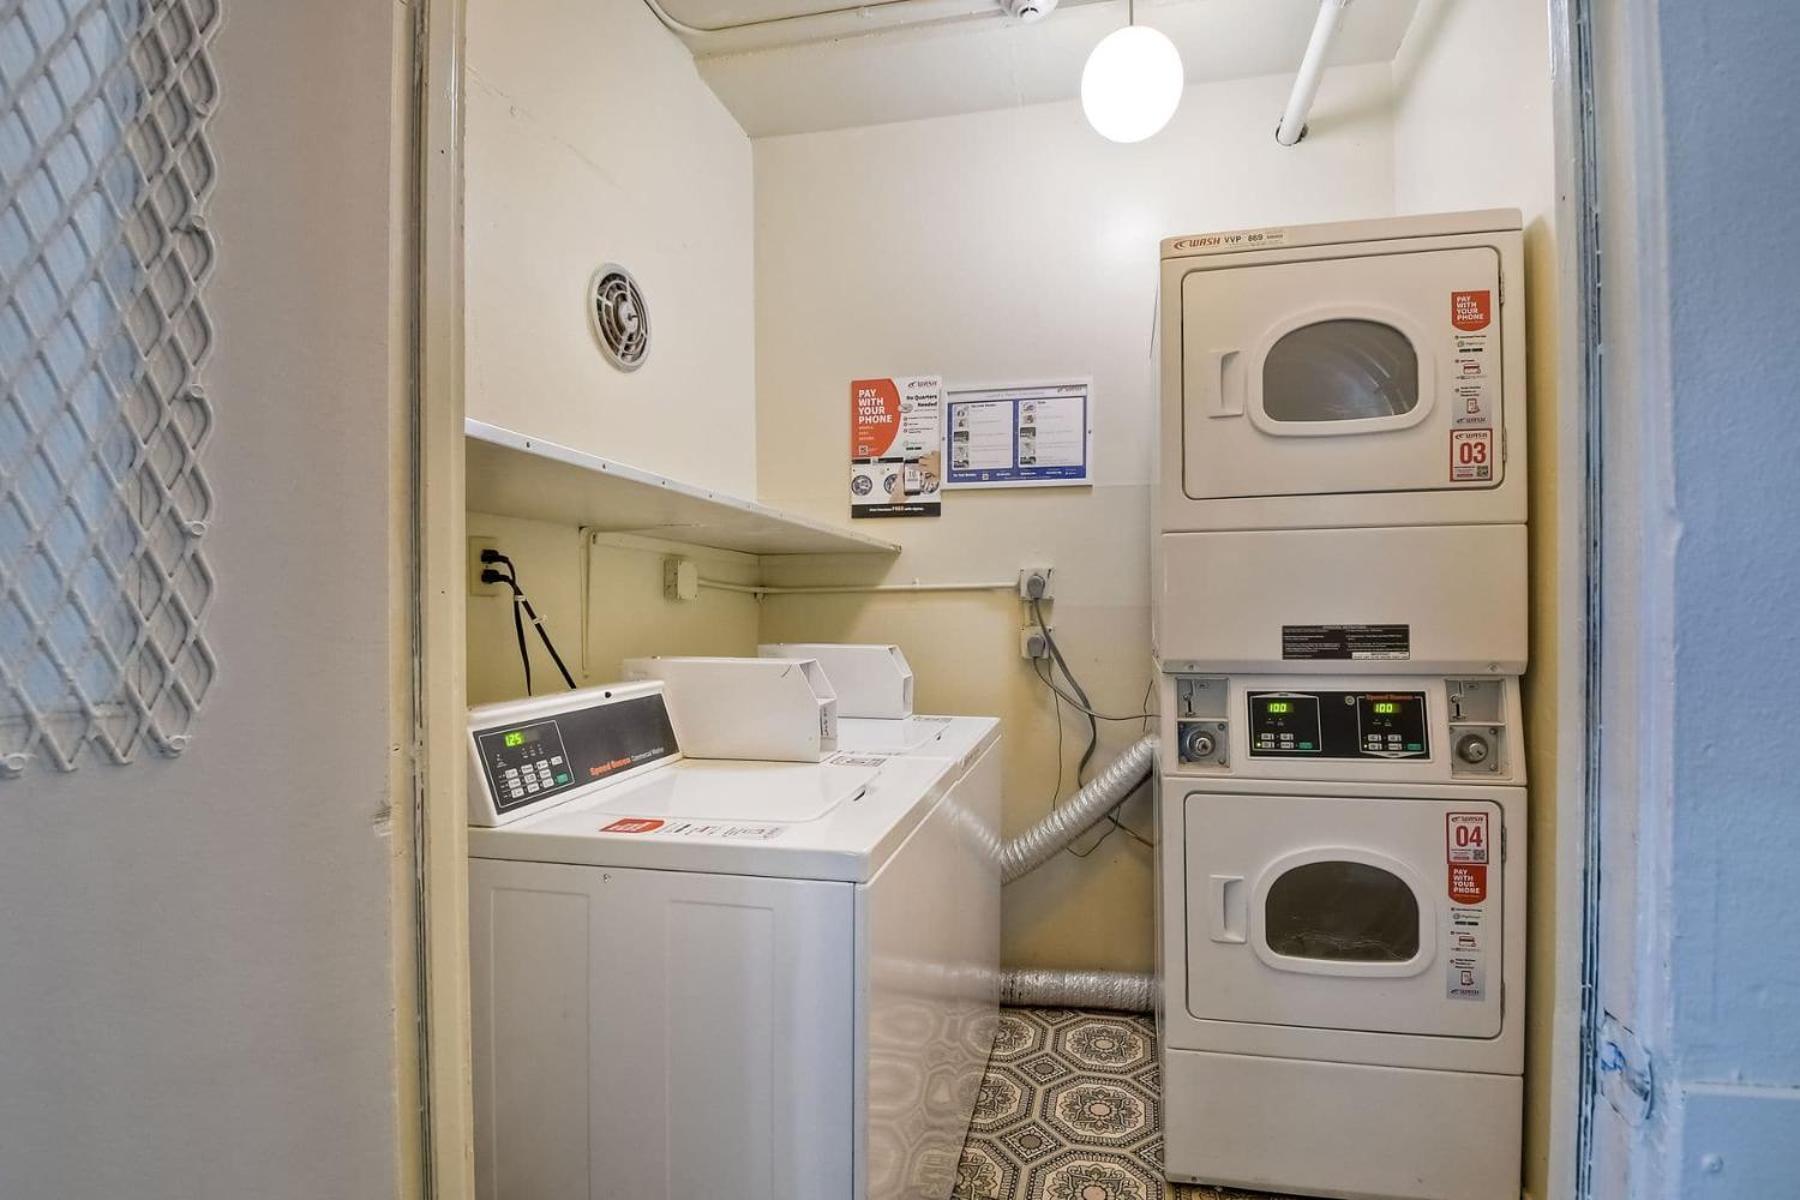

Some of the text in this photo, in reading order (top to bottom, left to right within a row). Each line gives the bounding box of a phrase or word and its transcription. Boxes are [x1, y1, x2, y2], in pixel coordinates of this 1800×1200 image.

[1188, 237, 1221, 248] WASH
[1456, 313, 1484, 321] PHONE
[858, 389, 877, 398] PAY
[858, 398, 884, 407] WITH
[858, 406, 885, 415] YOUR
[858, 415, 893, 425] PHONE
[1460, 442, 1486, 464] 03
[1456, 825, 1483, 847] 04
